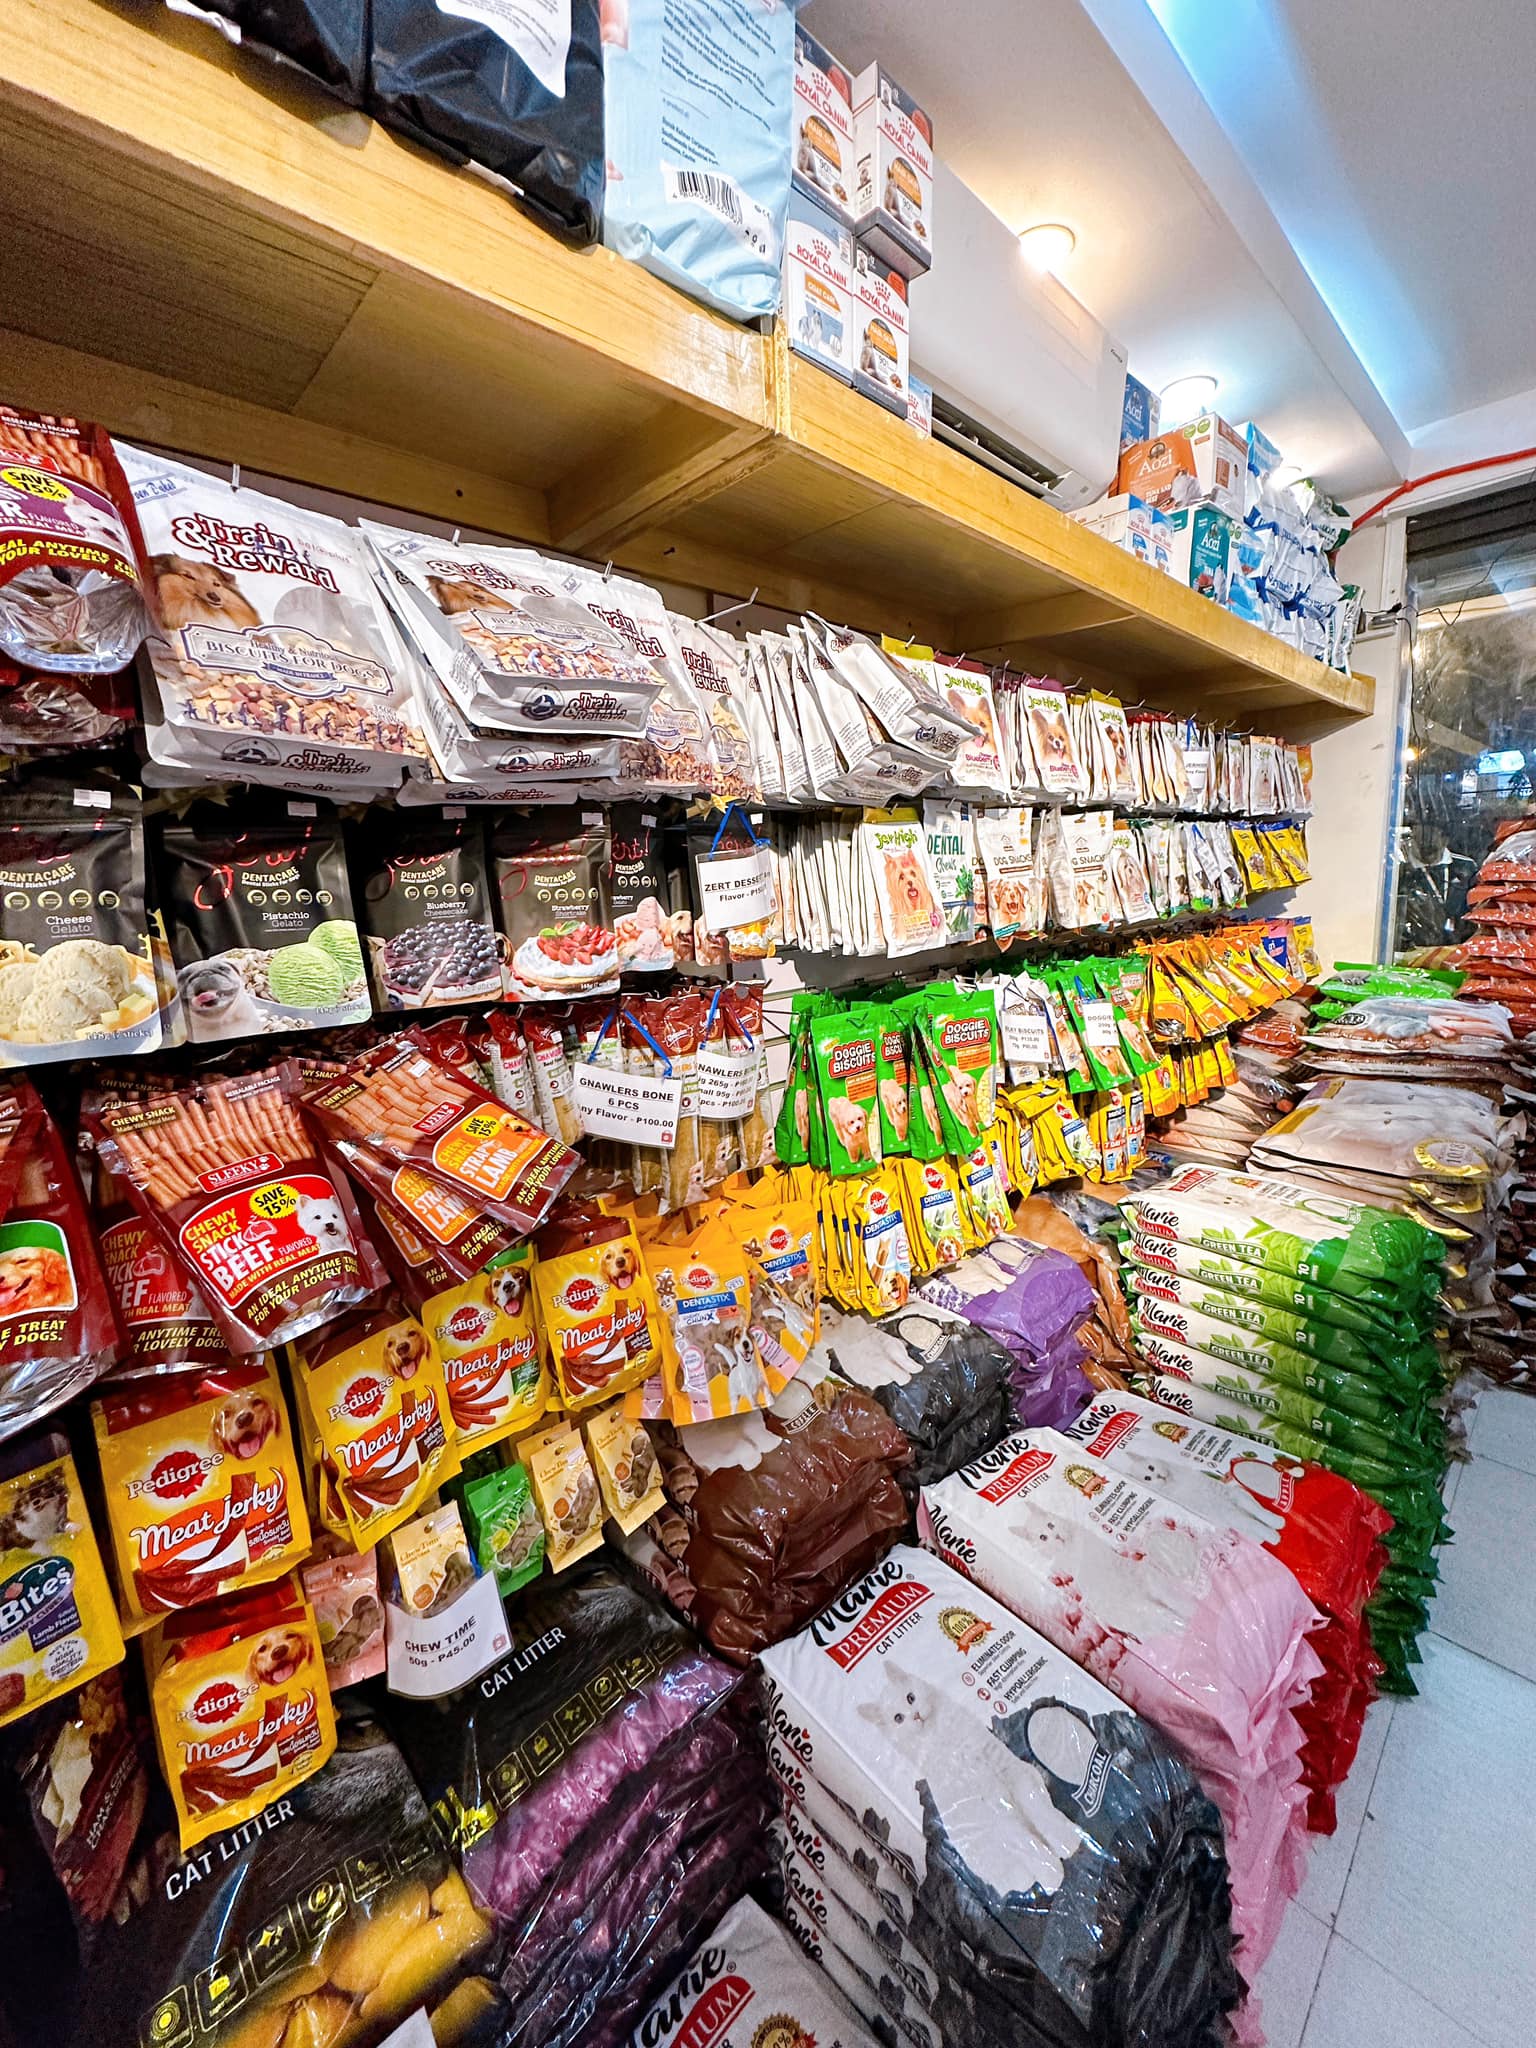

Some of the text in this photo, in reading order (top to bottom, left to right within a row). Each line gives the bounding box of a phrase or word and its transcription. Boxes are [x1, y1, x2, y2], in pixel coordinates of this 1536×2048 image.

[795, 75, 823, 108] ROYAL
[884, 119, 907, 150] ROYAL
[797, 244, 847, 288] ROYAL CANIN
[860, 286, 904, 326] ROYAL CANIN
[1139, 449, 1173, 477] Aozi
[7, 471, 54, 487] SAVE
[19, 481, 68, 499] 15%
[172, 515, 215, 553] &
[194, 512, 297, 557] Train
[1201, 533, 1220, 550] Aozi
[211, 542, 340, 594] Reward
[587, 602, 637, 638] Train
[205, 640, 376, 680] BISCUITS FOR DOGS
[682, 646, 714, 674] Train
[580, 692, 617, 709] Train
[554, 751, 592, 769] Train
[875, 828, 918, 849] JerHigh
[927, 834, 965, 855] DENTAL
[0, 862, 76, 883] DENTACARE
[241, 866, 300, 881] DENTACARE
[400, 863, 447, 882] DENTACARE
[994, 857, 1008, 866] DOG
[534, 870, 576, 884] DENTACARE
[704, 881, 732, 892] ZERT
[426, 901, 466, 911] Blueberry
[551, 904, 590, 912] Strawberry
[719, 893, 745, 902] Flavor
[45, 915, 93, 926] Cheese
[262, 911, 310, 921] Pistachio
[271, 919, 303, 928] Gelato
[423, 908, 469, 917] Cheesecake
[50, 924, 91, 934] Gelato
[945, 1029, 989, 1045] BISCUITS
[947, 1021, 985, 1034] DOGGIE
[833, 1053, 876, 1073] BISCUITS
[835, 1042, 872, 1061] DOGGIE
[579, 1077, 674, 1101] GNAWLERS BONE
[706, 1079, 729, 1088] 265g
[715, 1090, 731, 1099] 95g
[608, 1097, 640, 1111] 6 PCS
[700, 1099, 715, 1107] pcs
[111, 1106, 176, 1127] CHEWY SNACK
[466, 1118, 484, 1134] SAVE
[595, 1109, 628, 1122] Flavor
[478, 1120, 497, 1137] 15%
[207, 1159, 259, 1183] SLEEKY
[475, 1148, 518, 1189] LAMB
[254, 1186, 286, 1207] SAVE
[516, 1165, 541, 1204] AN IDEAL
[525, 1165, 552, 1206] FOR YOUR
[263, 1196, 296, 1217] 15%
[923, 1190, 952, 1204] DENTASTIX
[185, 1208, 237, 1241] CHEWY
[864, 1214, 898, 1234] DENTASTIX
[102, 1230, 147, 1250] CHEWY
[192, 1220, 242, 1254] SNACK
[460, 1242, 471, 1255] AN
[472, 1222, 495, 1243] IDEAL
[1135, 1232, 1178, 1258] Marie
[1203, 1238, 1261, 1258] GREEN TEA
[104, 1244, 138, 1265] SNACK
[200, 1232, 250, 1270] STICK
[467, 1244, 483, 1259] FOR
[763, 1253, 804, 1269] DENTASTIX
[212, 1236, 313, 1292] BEEF FLAVORED
[229, 1244, 321, 1300] MADE WITH REAL MEAT
[247, 1304, 259, 1319] AN
[259, 1279, 289, 1309] IDEAL
[293, 1257, 342, 1283] ANYTIME
[431, 1272, 448, 1284] FOR
[1201, 1270, 1258, 1288] GREEN TEA
[148, 1291, 187, 1304] FLAVORED
[254, 1309, 270, 1326] FOR
[270, 1286, 300, 1310] YOUR
[303, 1265, 342, 1288] LOVELY
[552, 1283, 610, 1308] Pedigree
[682, 1293, 730, 1308] DENTASTIX
[136, 1303, 191, 1316] REAL MEAT
[1142, 1298, 1188, 1331] Marie
[1204, 1304, 1261, 1324] GREEN TEA
[18, 1320, 67, 1332] TREAT
[138, 1326, 200, 1343] ANYTIME
[436, 1310, 497, 1339] Pedigree
[556, 1322, 606, 1350] Meat
[13, 1330, 63, 1346] DOGS.
[144, 1336, 227, 1352] LOVELY DOGS.
[1150, 1339, 1194, 1371] Marie
[1211, 1345, 1269, 1368] GREEN TEA
[442, 1353, 490, 1384] Meat
[327, 1375, 395, 1422] Pedigree
[1149, 1376, 1194, 1410] Marie
[1216, 1387, 1276, 1410] GREEN TEA
[1091, 1412, 1136, 1454] PREMIUM
[1118, 1437, 1128, 1450] CAT
[335, 1425, 395, 1469] Meat
[127, 1452, 224, 1499] Pedigree
[958, 1438, 1029, 1489] Marie
[987, 1451, 1048, 1498] PREMIUM
[1017, 1473, 1051, 1499] CAT LITTER
[1108, 1491, 1138, 1526] FAST CLUMPING
[1123, 1497, 1157, 1532] HYPOALLERGENIC
[129, 1511, 215, 1559] Meat
[928, 1505, 977, 1565] Marie
[0, 1566, 71, 1633] Bites
[810, 1560, 903, 1647] Marie
[33, 1624, 55, 1640] Lamb
[55, 1612, 78, 1629] Flavor
[405, 1615, 477, 1653] CHEW TIME
[837, 1584, 924, 1660] PREMIUM
[876, 1611, 924, 1656] CAT LITTER
[951, 1617, 974, 1634] 100%
[409, 1633, 476, 1668] 50g P45.00
[480, 1627, 566, 1698] CAT LITTER
[971, 1641, 1002, 1673] ELIMINATES
[1000, 1630, 1017, 1647] ODOR
[986, 1669, 1003, 1687] FAST
[999, 1647, 1028, 1674] CLUMPING
[1003, 1656, 1049, 1701] HYPOALLERGENIC
[176, 1682, 259, 1723] Pedigree
[768, 1677, 814, 1762] Marie
[178, 1731, 250, 1763] Meat
[165, 1800, 297, 1900] CAT LITTER
